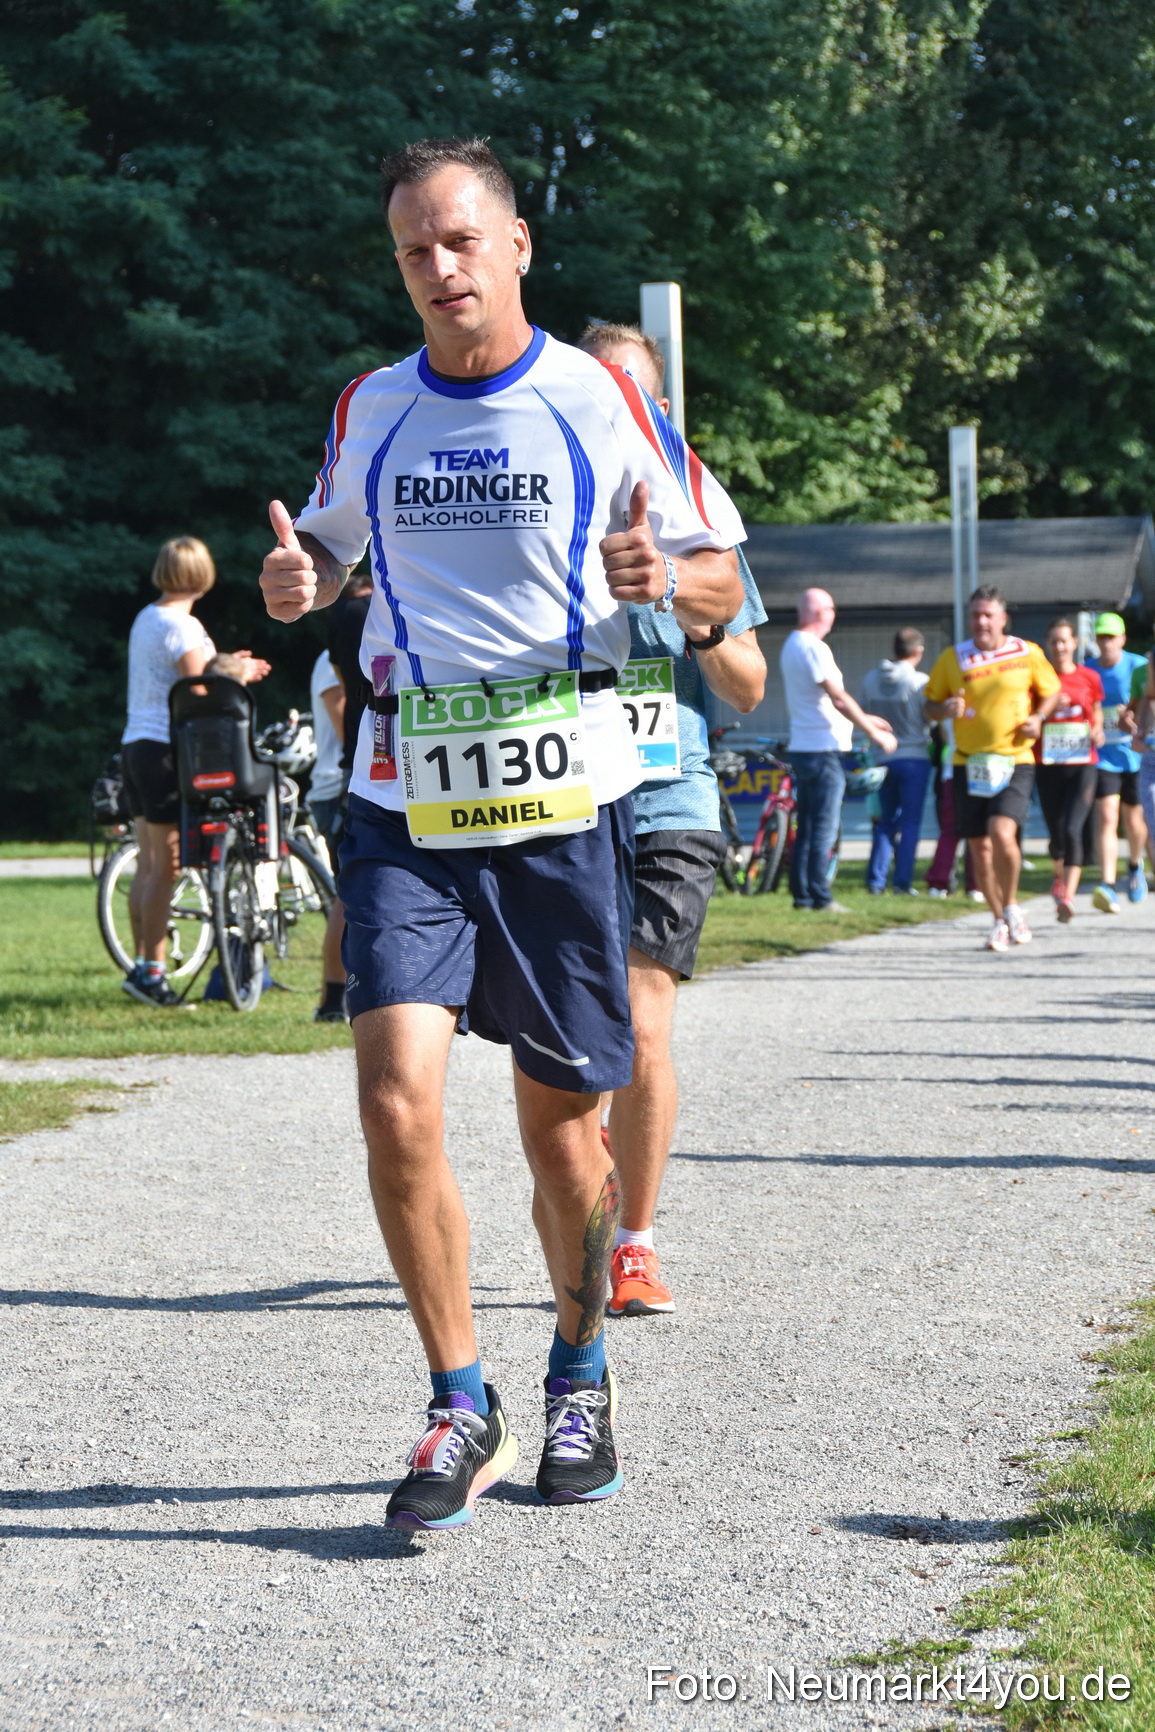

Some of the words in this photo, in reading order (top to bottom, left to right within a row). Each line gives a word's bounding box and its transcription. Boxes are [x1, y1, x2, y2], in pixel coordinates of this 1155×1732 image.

[429, 448, 509, 471] TEAM
[394, 473, 553, 507] ERDINGER
[395, 510, 548, 526] ALKOHOLFREI
[414, 679, 566, 729] BOCK
[424, 732, 568, 791] 1130
[570, 732, 577, 741] C
[451, 801, 554, 828] DANIEL
